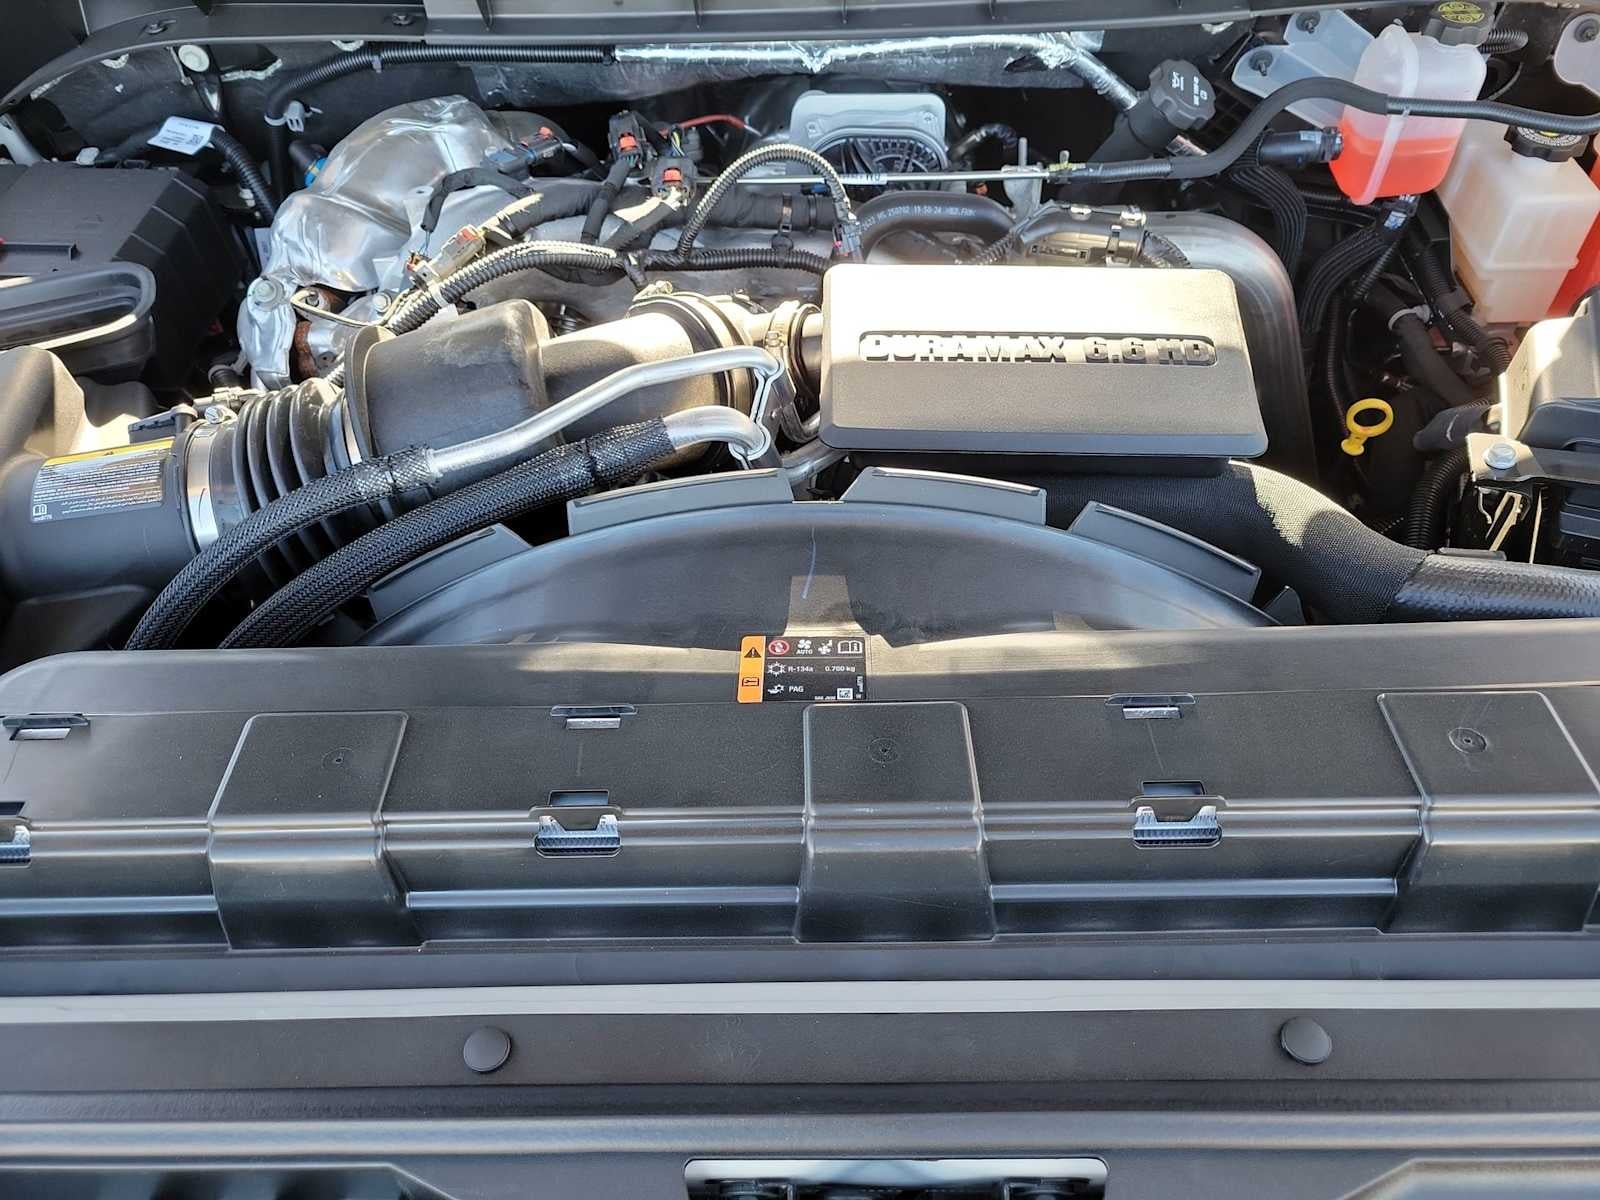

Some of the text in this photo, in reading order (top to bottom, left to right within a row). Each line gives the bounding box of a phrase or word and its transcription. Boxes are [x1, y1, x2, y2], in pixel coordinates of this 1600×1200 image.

[860, 334, 1216, 365] DURAMAX 6.6 HD
[846, 665, 856, 673] kg
[788, 685, 804, 693] PAG
